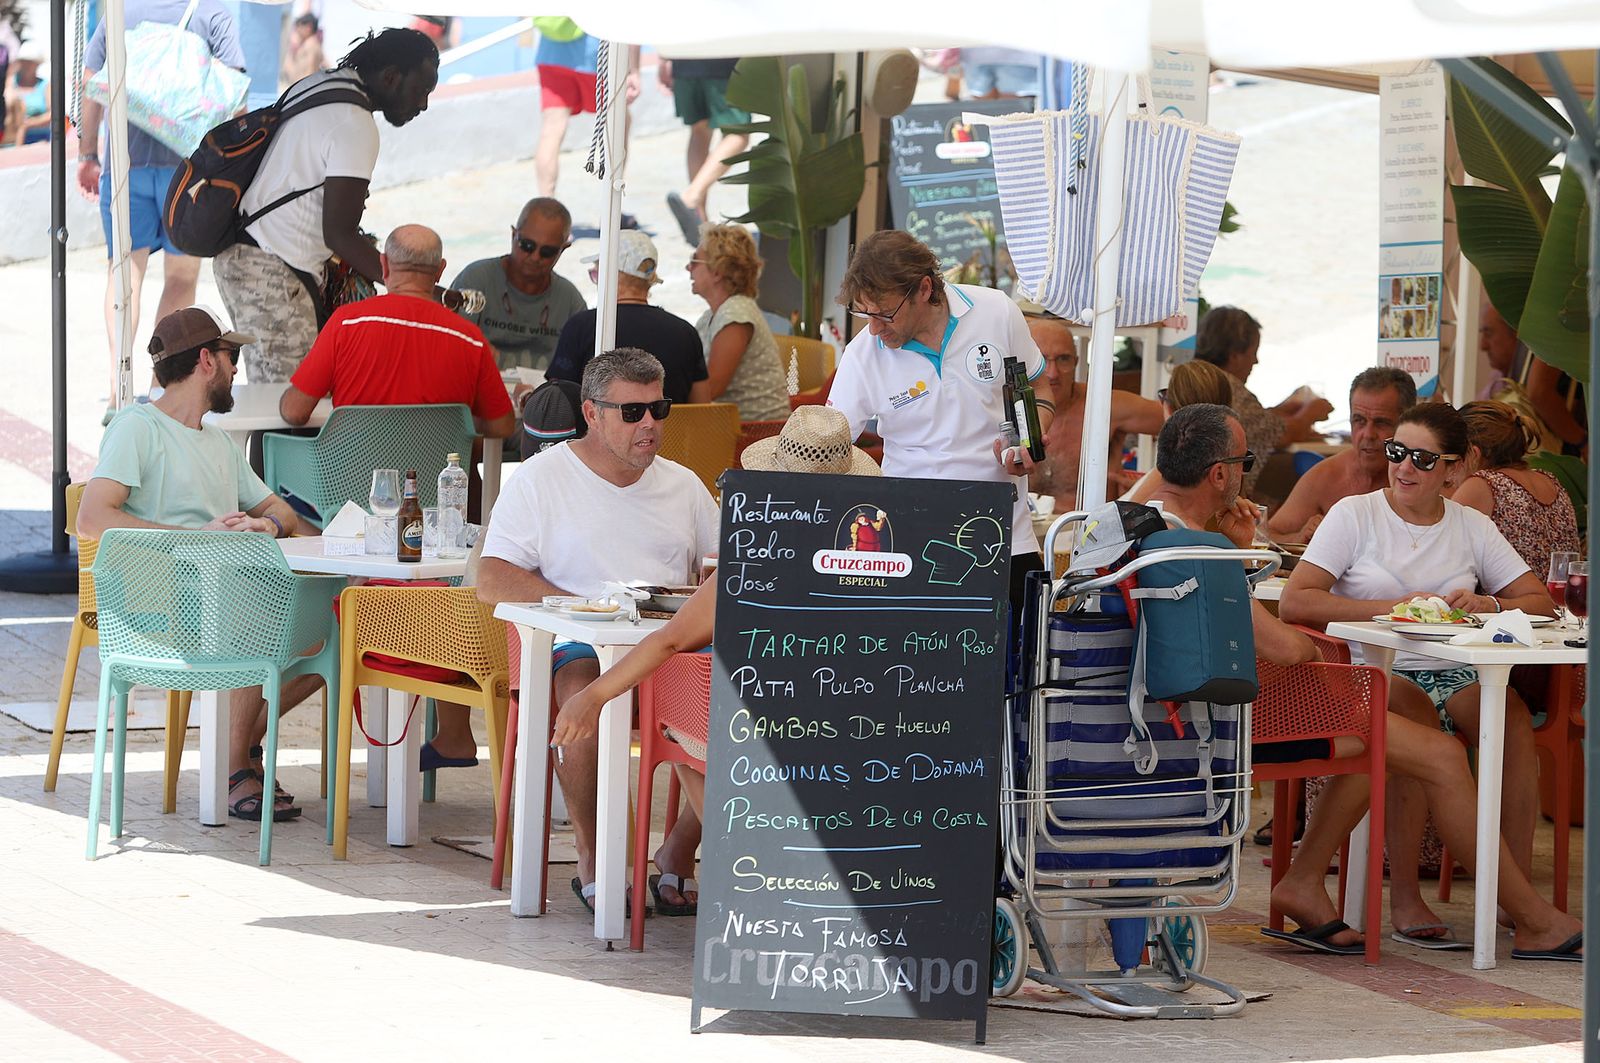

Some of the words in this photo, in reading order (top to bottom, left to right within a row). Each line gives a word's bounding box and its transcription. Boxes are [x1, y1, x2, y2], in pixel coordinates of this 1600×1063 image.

[484, 317, 526, 333] CHOOSE
[728, 492, 832, 525] Restaurante
[728, 529, 796, 560] Pedro
[726, 561, 778, 596] José
[820, 553, 906, 574] Cruzcampo
[838, 576, 888, 587] ESPECIAL
[739, 628, 847, 659] TARTAR
[858, 634, 889, 655] DE
[903, 631, 948, 655] ATÚN
[730, 665, 795, 698] PATA
[812, 667, 875, 697] PULPO
[883, 664, 965, 697] PLANCHA
[729, 708, 838, 743] GAMBAS
[849, 715, 885, 740] DE
[730, 756, 851, 787] COQUINAS
[862, 760, 901, 783] DE
[904, 753, 985, 783] DOÑANA
[723, 796, 853, 833] PESCAITOS
[862, 805, 897, 829] DE
[932, 808, 989, 829] COSTA
[732, 856, 840, 893] SELECCIÓN
[848, 870, 882, 893] DE
[812, 916, 908, 952] FAMOSA
[703, 937, 978, 1002] Cruzcampo
